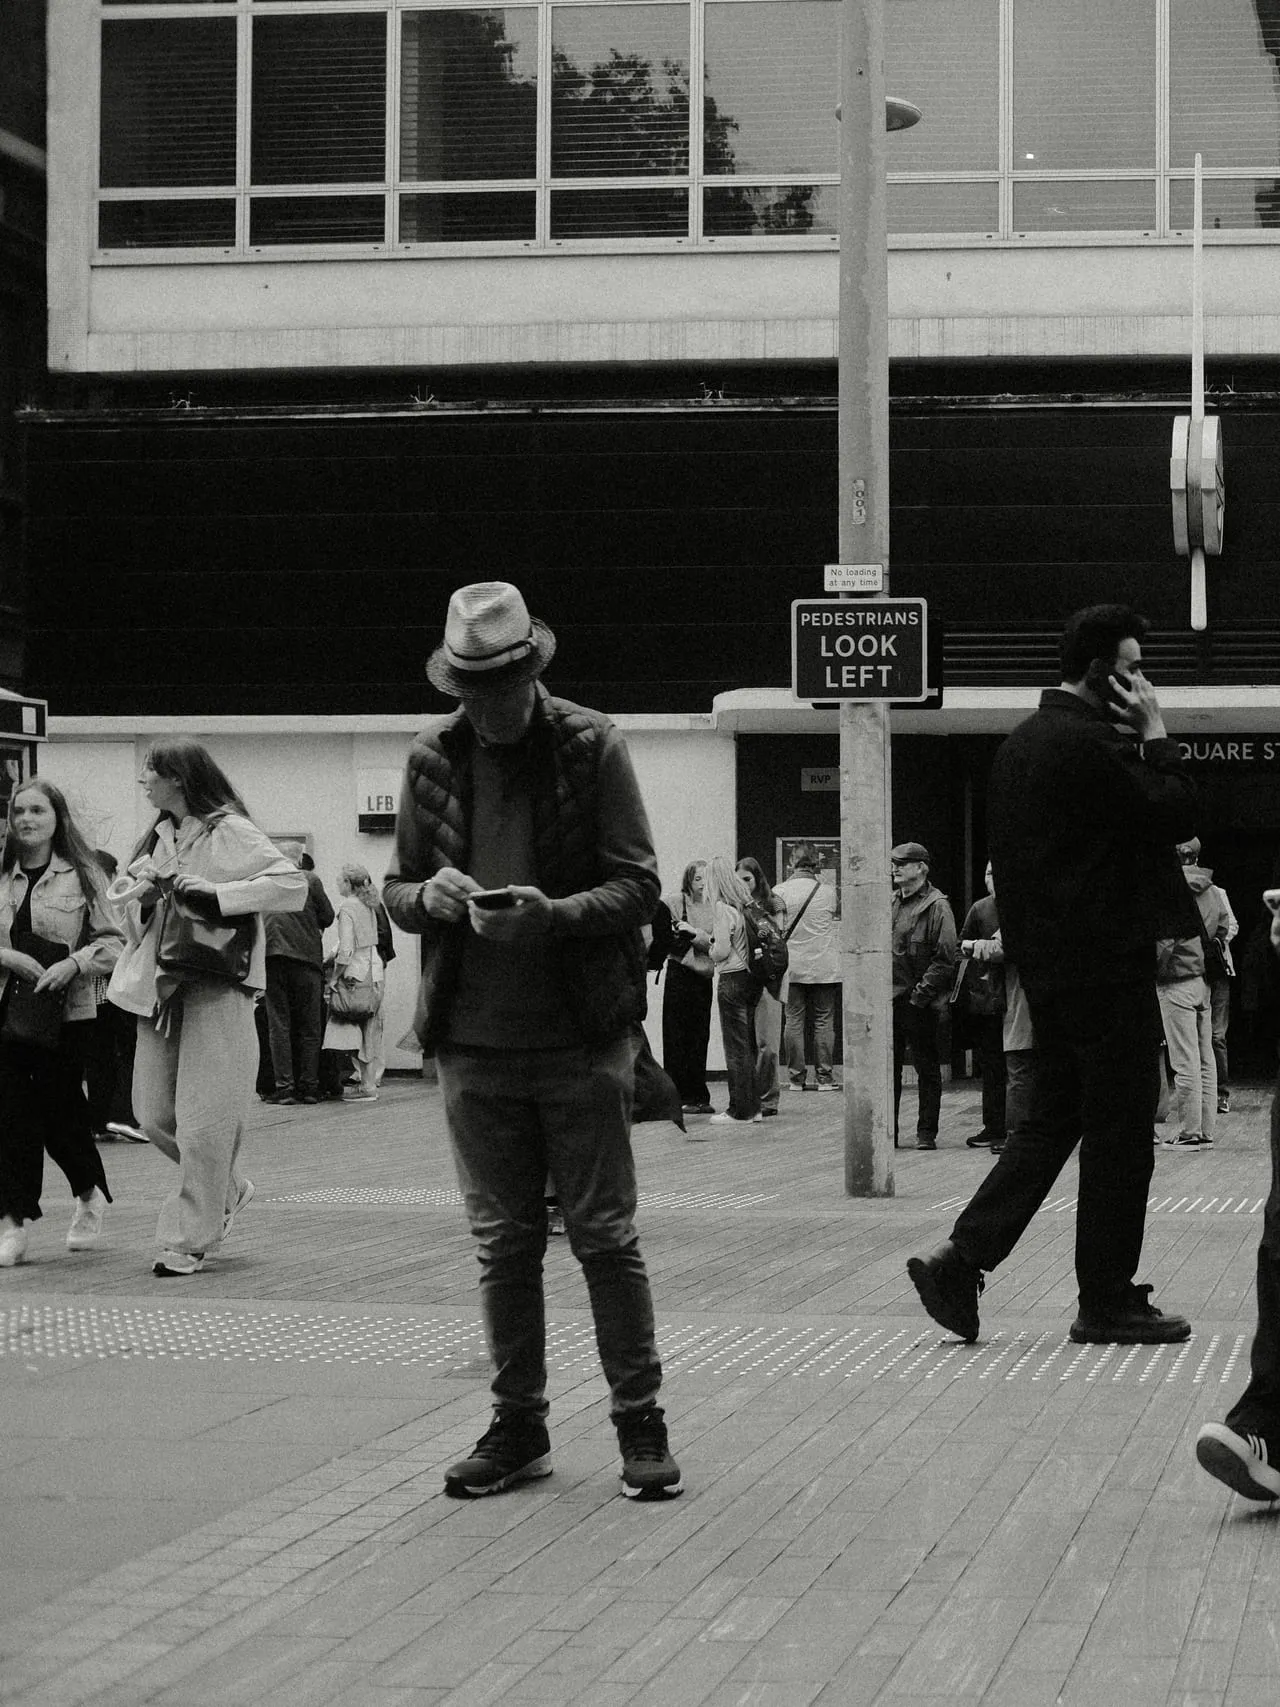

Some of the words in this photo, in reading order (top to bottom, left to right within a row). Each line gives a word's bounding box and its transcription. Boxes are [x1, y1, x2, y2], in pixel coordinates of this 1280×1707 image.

[846, 568, 877, 577] loading
[841, 580, 855, 588] any
[860, 579, 879, 587] time
[801, 611, 919, 626] PEDESTRIANS
[821, 634, 898, 657] LOOK
[826, 665, 893, 688] LEFT
[1178, 742, 1254, 760] QUARE
[810, 774, 831, 784] RVP
[367, 795, 394, 811] LFB
